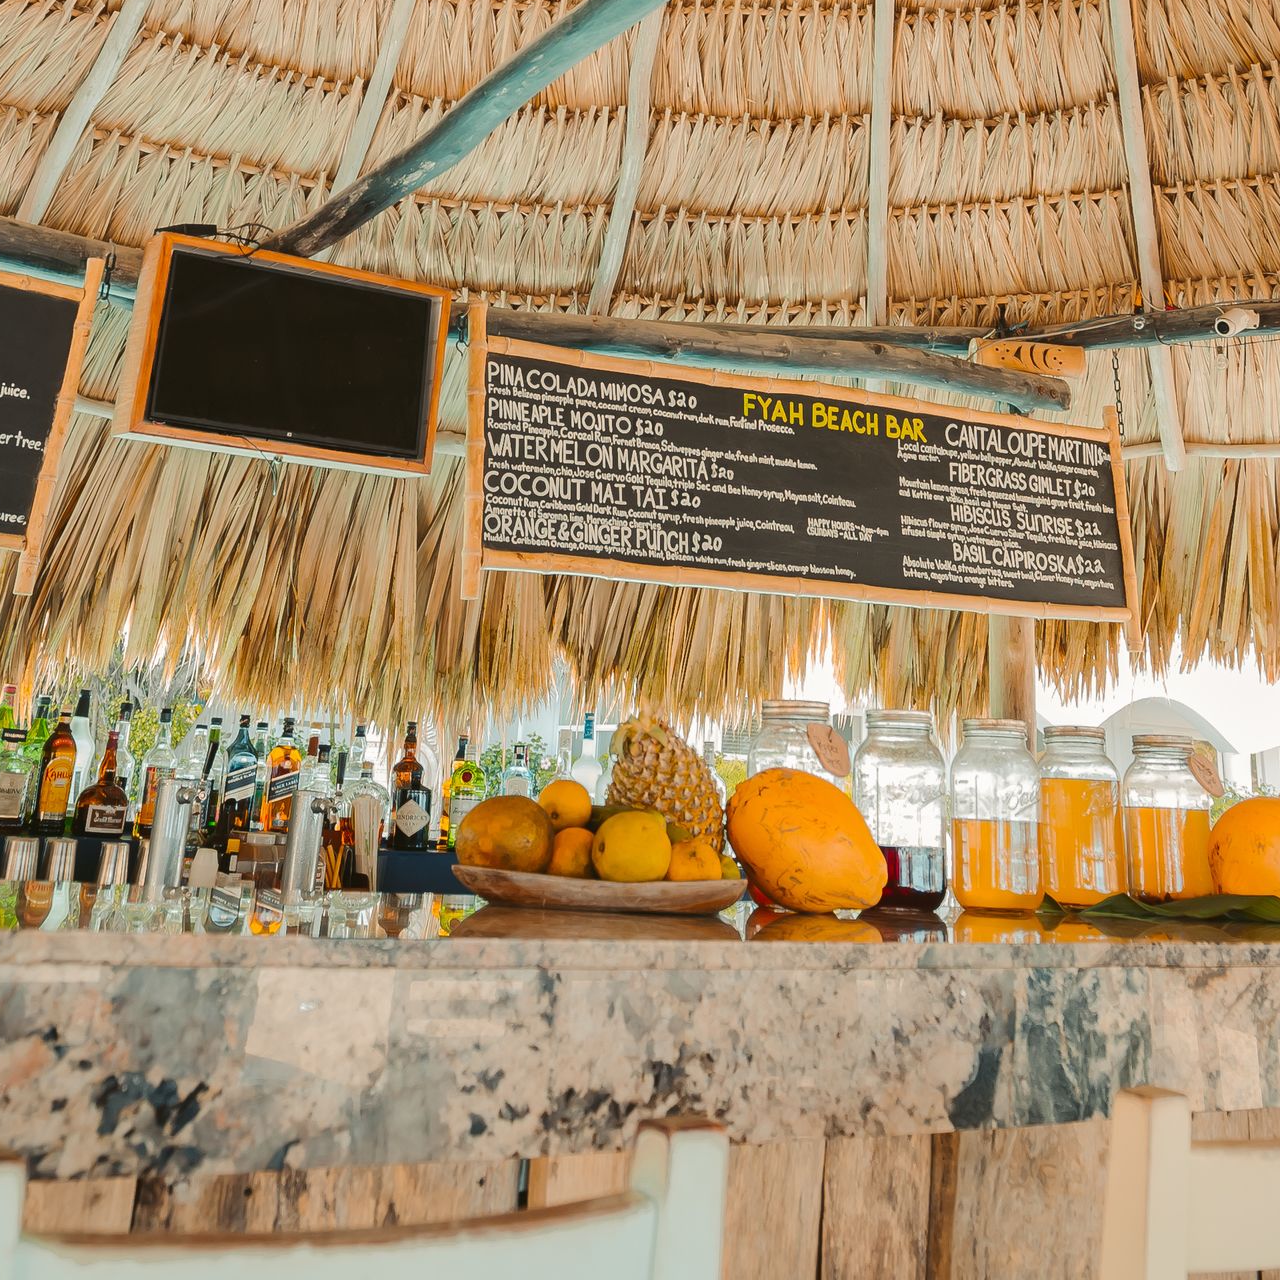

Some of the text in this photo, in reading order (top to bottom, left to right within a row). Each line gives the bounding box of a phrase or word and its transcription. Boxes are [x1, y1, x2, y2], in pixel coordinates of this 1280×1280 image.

[487, 360, 698, 410] PINA COLADA MIMOSA $20
[488, 396, 664, 437] PINNEAPLE MOJITO $20
[742, 392, 928, 444] FYAH BEACH BAR
[14, 430, 48, 452] tree.
[944, 422, 1100, 467] CANTALOUPE MARTINI
[616, 446, 709, 482] MARGARITA
[710, 462, 735, 481] $20
[948, 461, 1096, 502] FIBERGRASS GIMLET $20
[483, 470, 702, 511] COCONUT MAI TAI $20
[807, 517, 833, 530] HAPPY
[950, 503, 1102, 539] HIBISCUS SUNRISE $22
[691, 530, 723, 554] $20
[952, 542, 1106, 576] BASIL CAIPIROSKA $22
